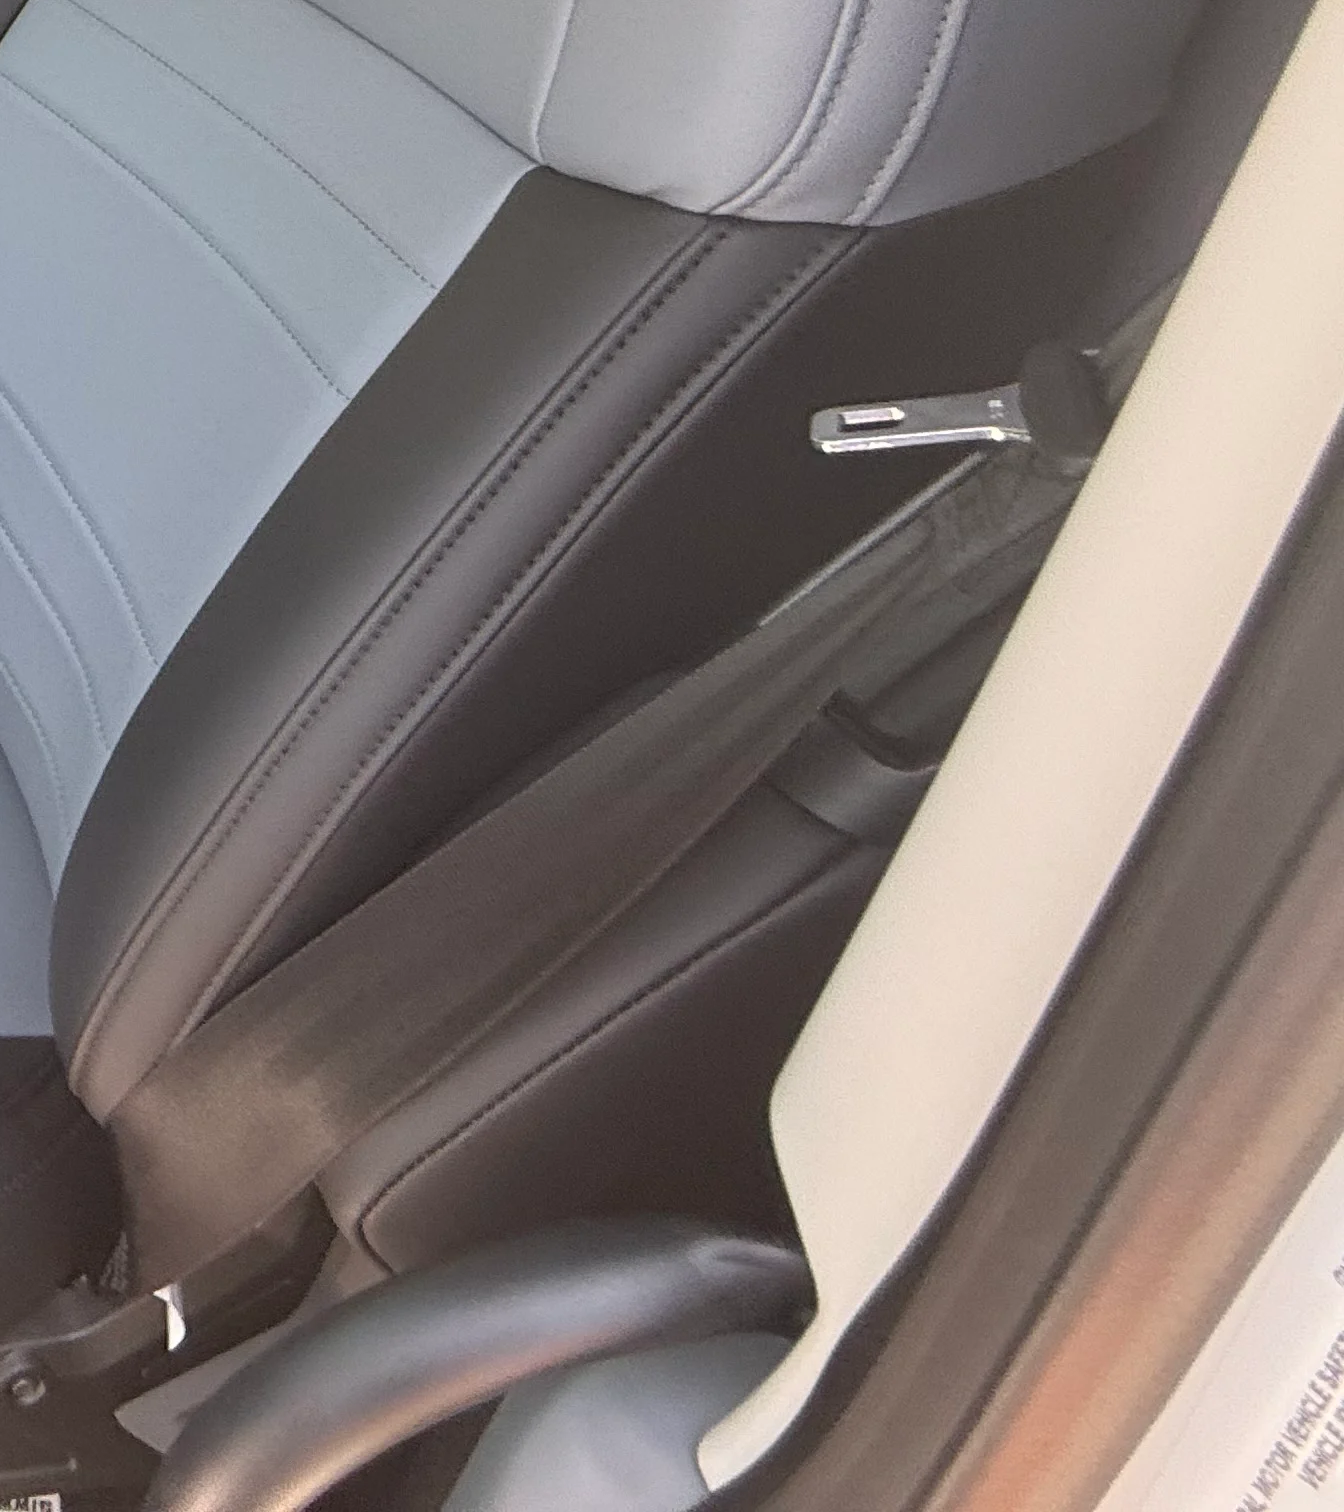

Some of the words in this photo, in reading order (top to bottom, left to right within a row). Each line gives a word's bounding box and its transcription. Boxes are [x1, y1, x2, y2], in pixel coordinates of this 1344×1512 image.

[1250, 1440, 1298, 1501] MOTOR
[1280, 1379, 1333, 1449] VEHICLE
[1297, 1420, 1344, 1490] VEHICLE
